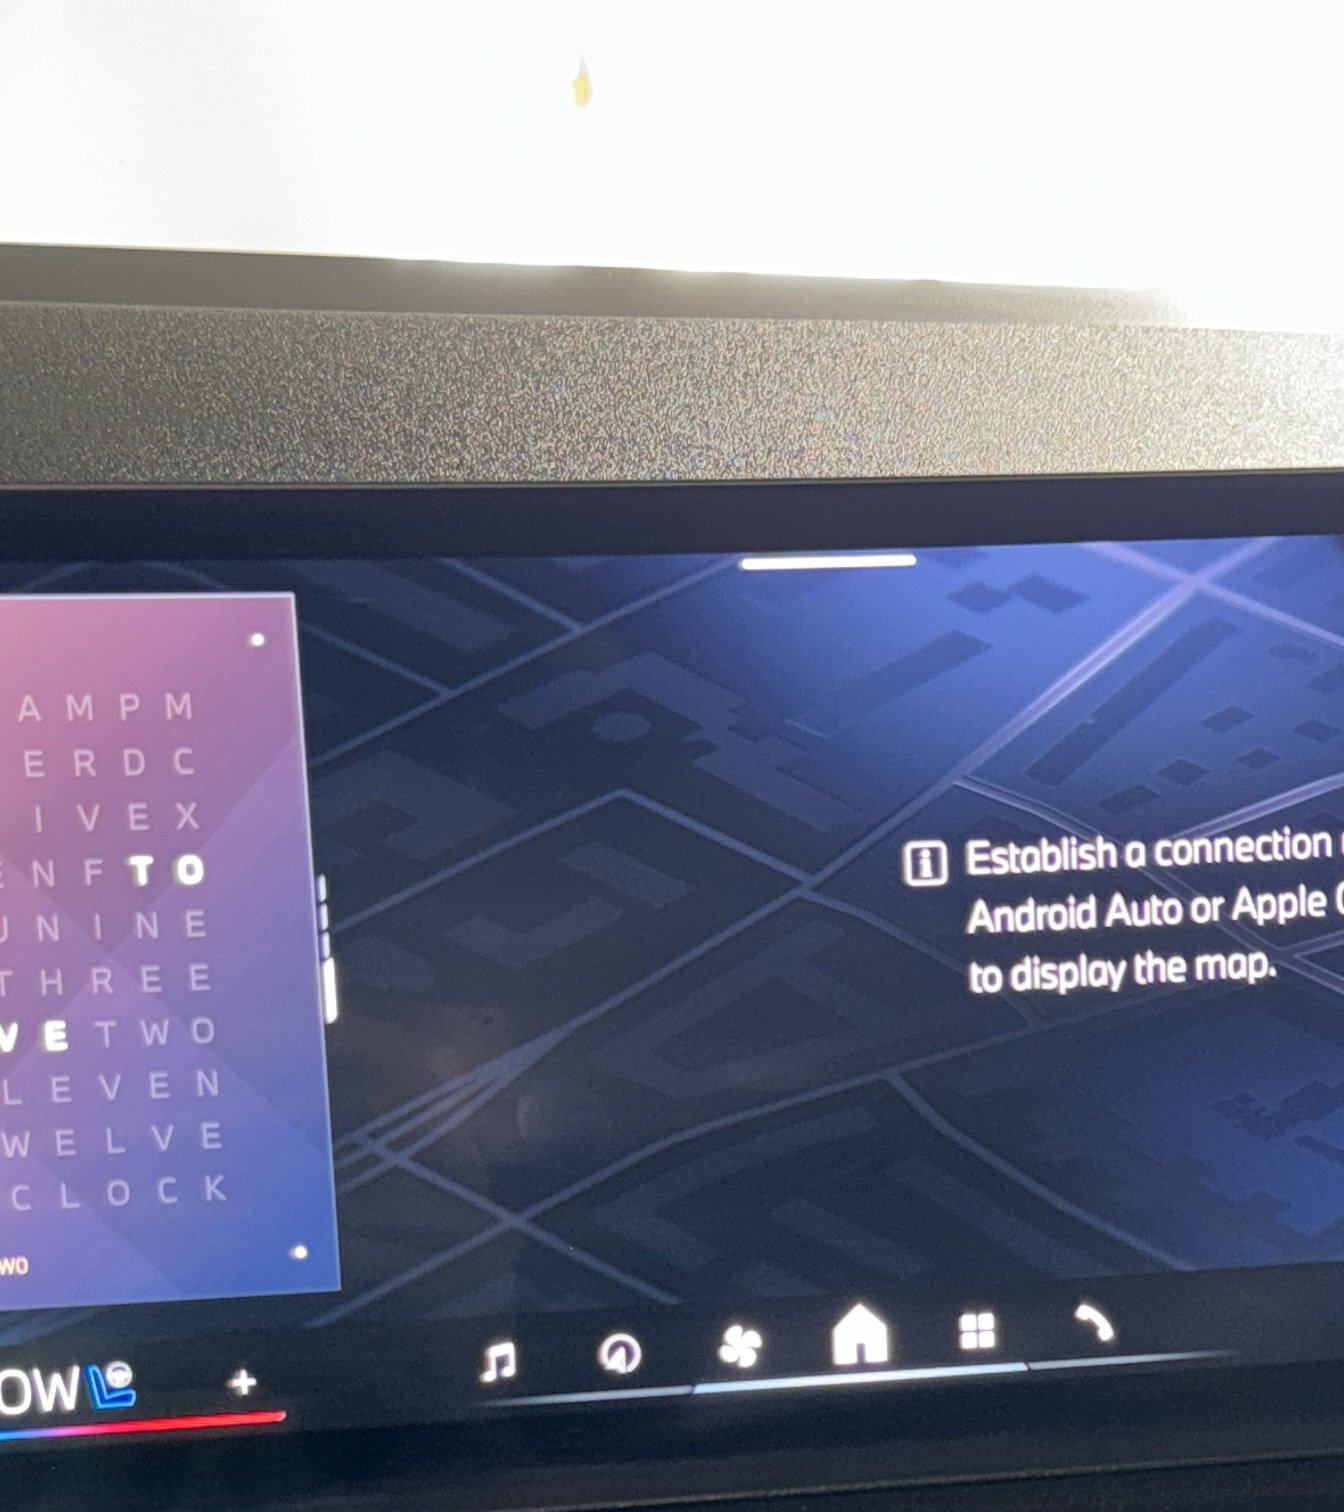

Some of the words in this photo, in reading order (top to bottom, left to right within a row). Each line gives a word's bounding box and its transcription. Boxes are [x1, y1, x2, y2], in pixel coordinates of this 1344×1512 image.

[966, 835, 1118, 875] Establish
[1125, 843, 1147, 868] a
[1155, 825, 1333, 867] connection
[966, 893, 1097, 934] Android
[1104, 890, 1184, 929] Auto
[1190, 892, 1225, 922] or
[1231, 884, 1328, 925] Apple
[968, 959, 1003, 994] to
[1010, 955, 1127, 995] display
[1133, 949, 1187, 987] the
[1194, 950, 1277, 985] map.
